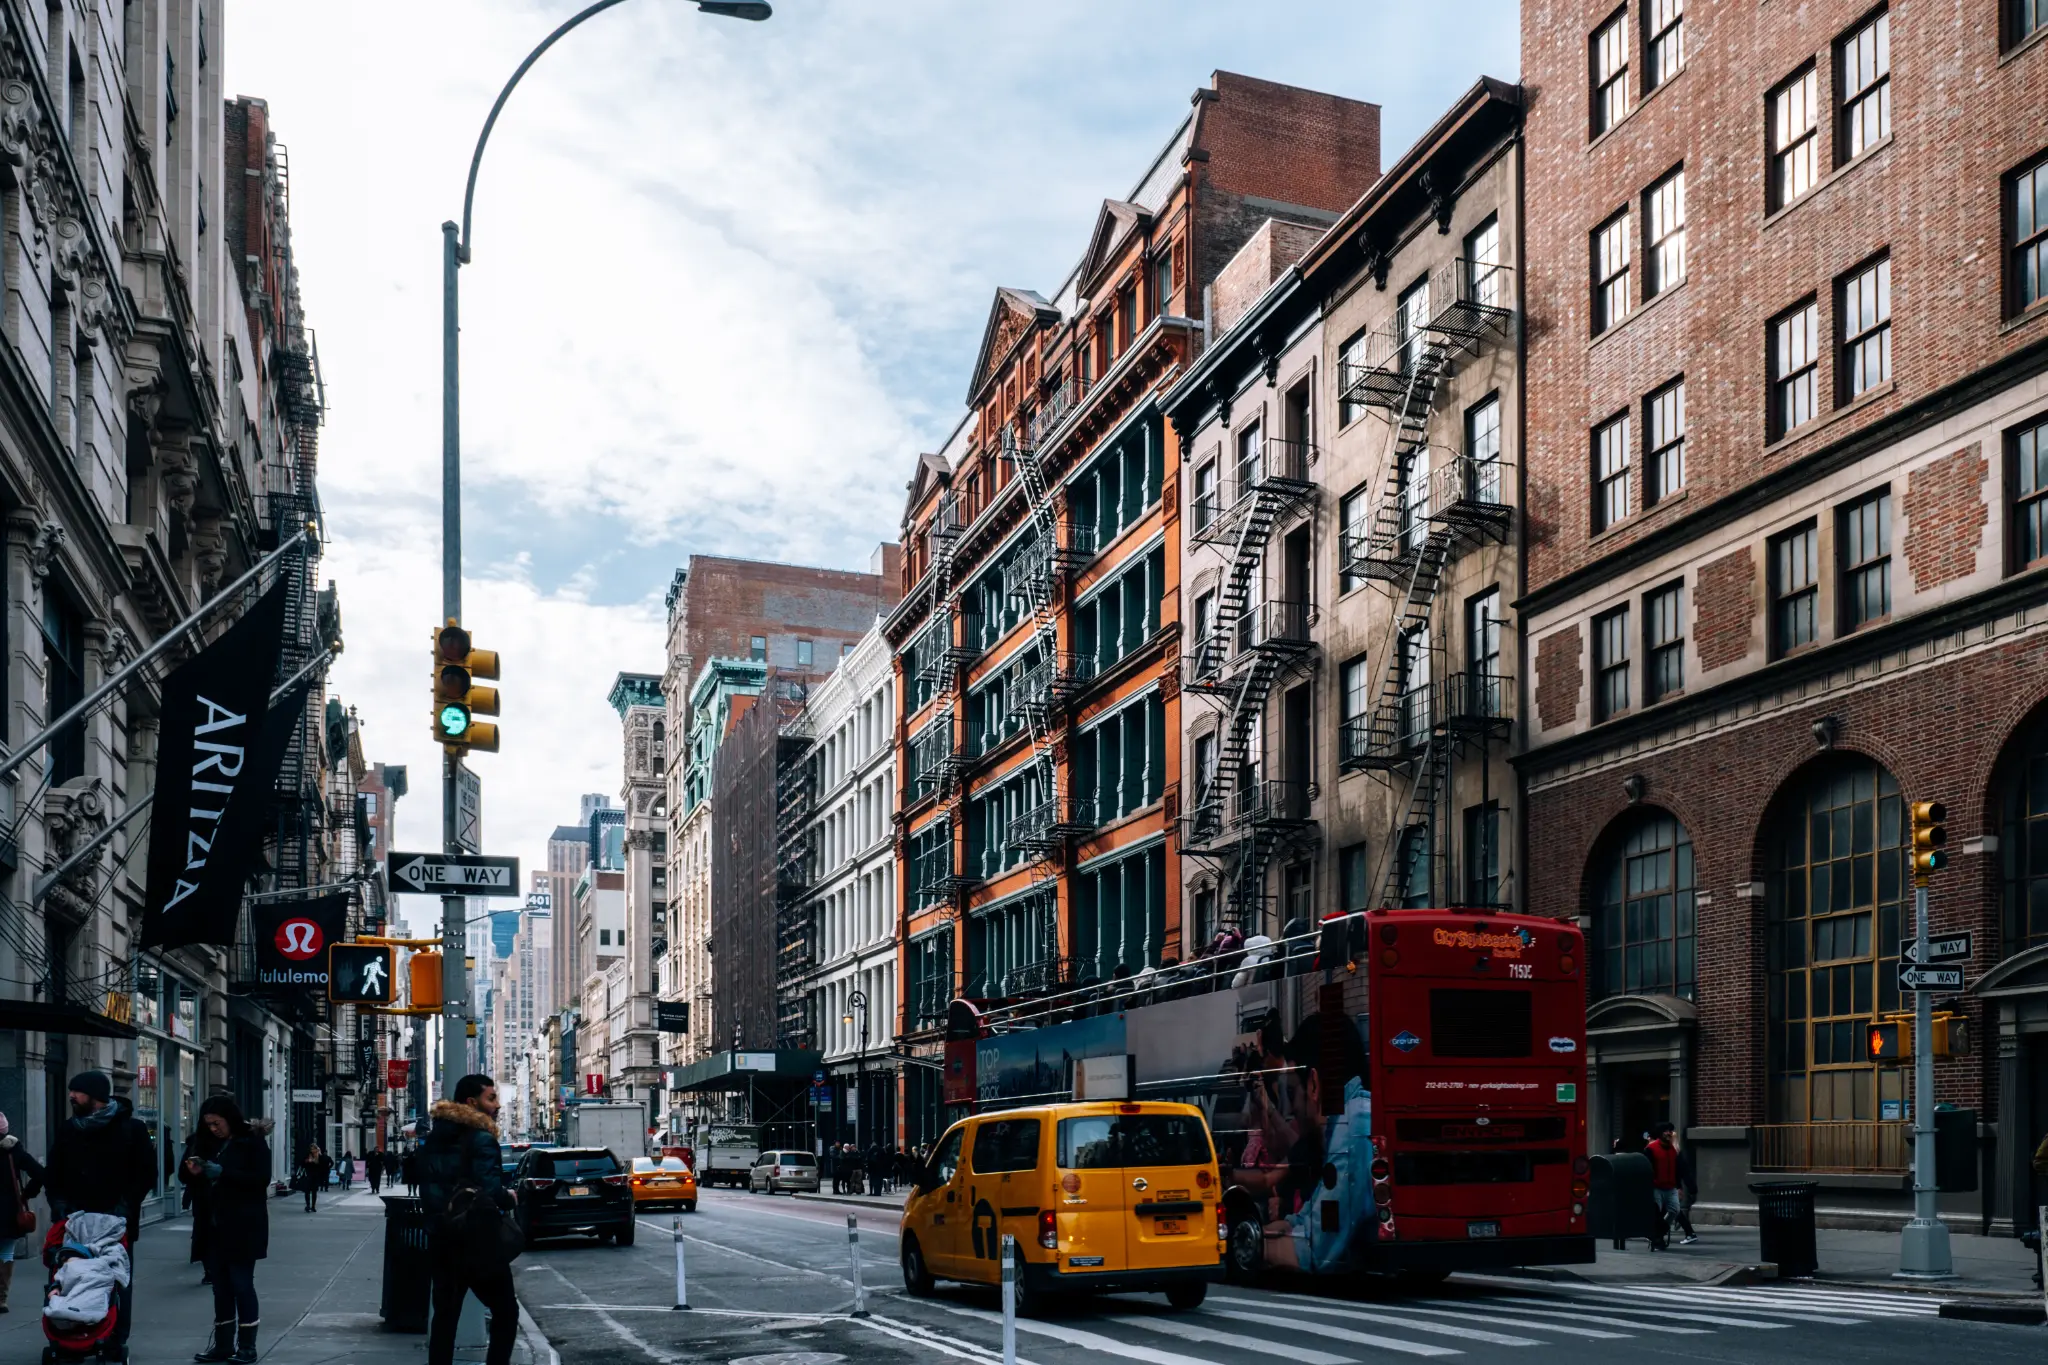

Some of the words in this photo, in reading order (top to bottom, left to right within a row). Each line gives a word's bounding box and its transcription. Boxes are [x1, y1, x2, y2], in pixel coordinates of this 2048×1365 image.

[408, 865, 446, 882] ONE
[463, 867, 502, 884] WAY
[528, 895, 550, 906] 401
[1939, 941, 1962, 954] WAY
[1906, 971, 1927, 983] ONE
[1936, 972, 1958, 983] WAY
[979, 1047, 1000, 1071] TOP
[988, 1072, 1000, 1084] THE
[980, 1085, 1000, 1100] ROCK
